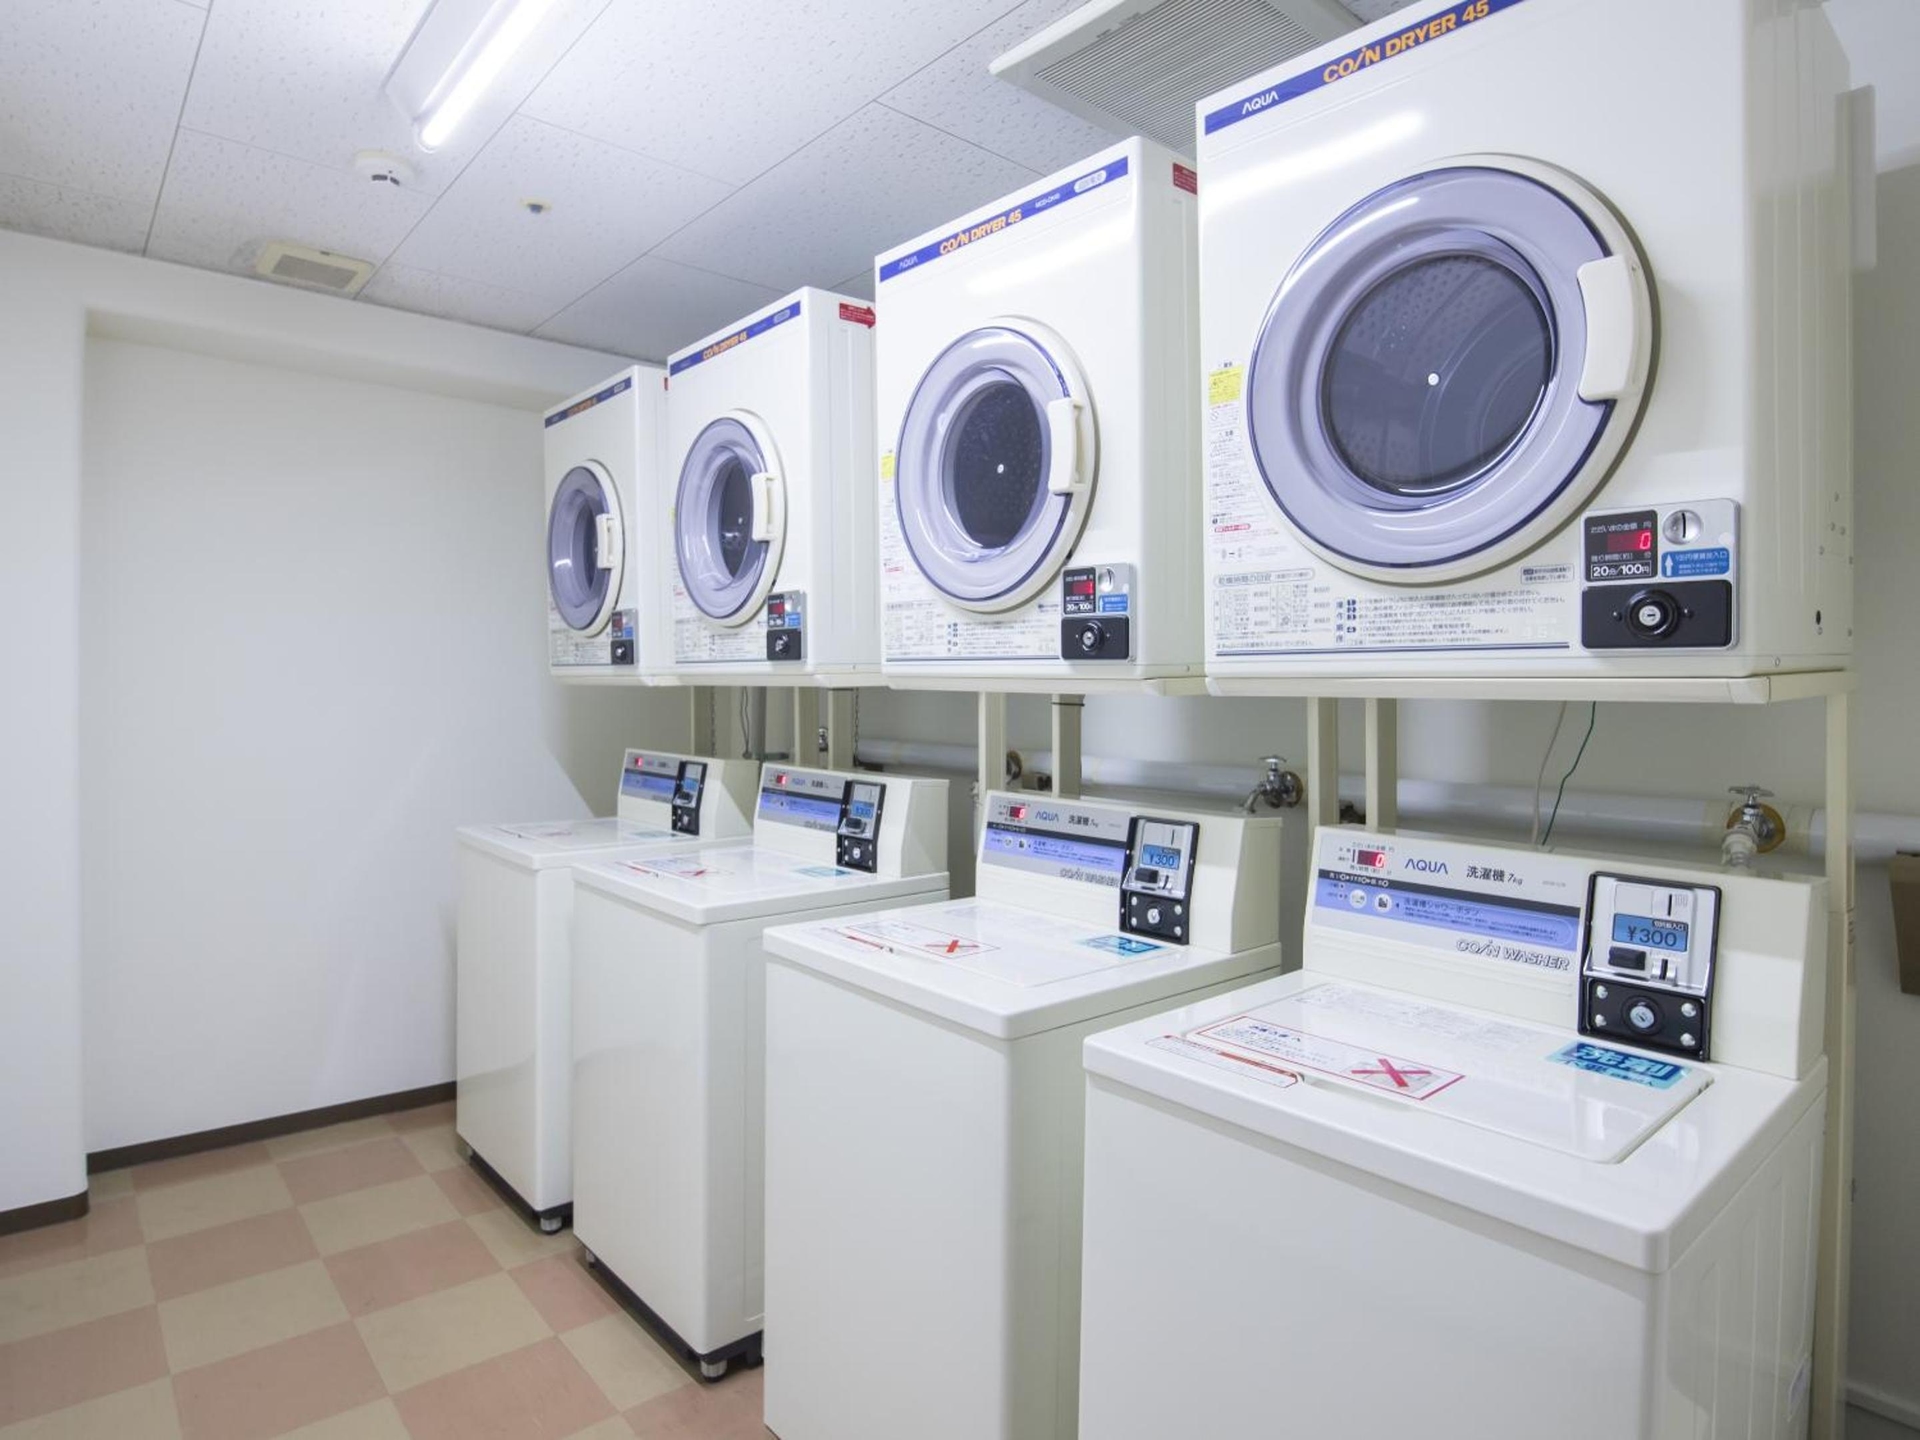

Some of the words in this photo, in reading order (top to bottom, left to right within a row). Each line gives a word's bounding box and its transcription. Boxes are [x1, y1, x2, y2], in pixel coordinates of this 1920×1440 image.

[1242, 90, 1279, 115] AQUA
[1385, 12, 1457, 58] DRYER
[1462, 0, 1490, 22] 45
[898, 255, 918, 270] AQUA
[970, 215, 1007, 242] DRYER
[1007, 208, 1023, 224] 45
[1639, 531, 1651, 550] 0
[1035, 810, 1060, 823] AQUA
[1375, 853, 1385, 867] 0
[1405, 857, 1449, 875] AQUA
[1466, 865, 1506, 883] 洗濯機
[1627, 925, 1678, 947] ¥300
[1503, 948, 1571, 971] WASHER
